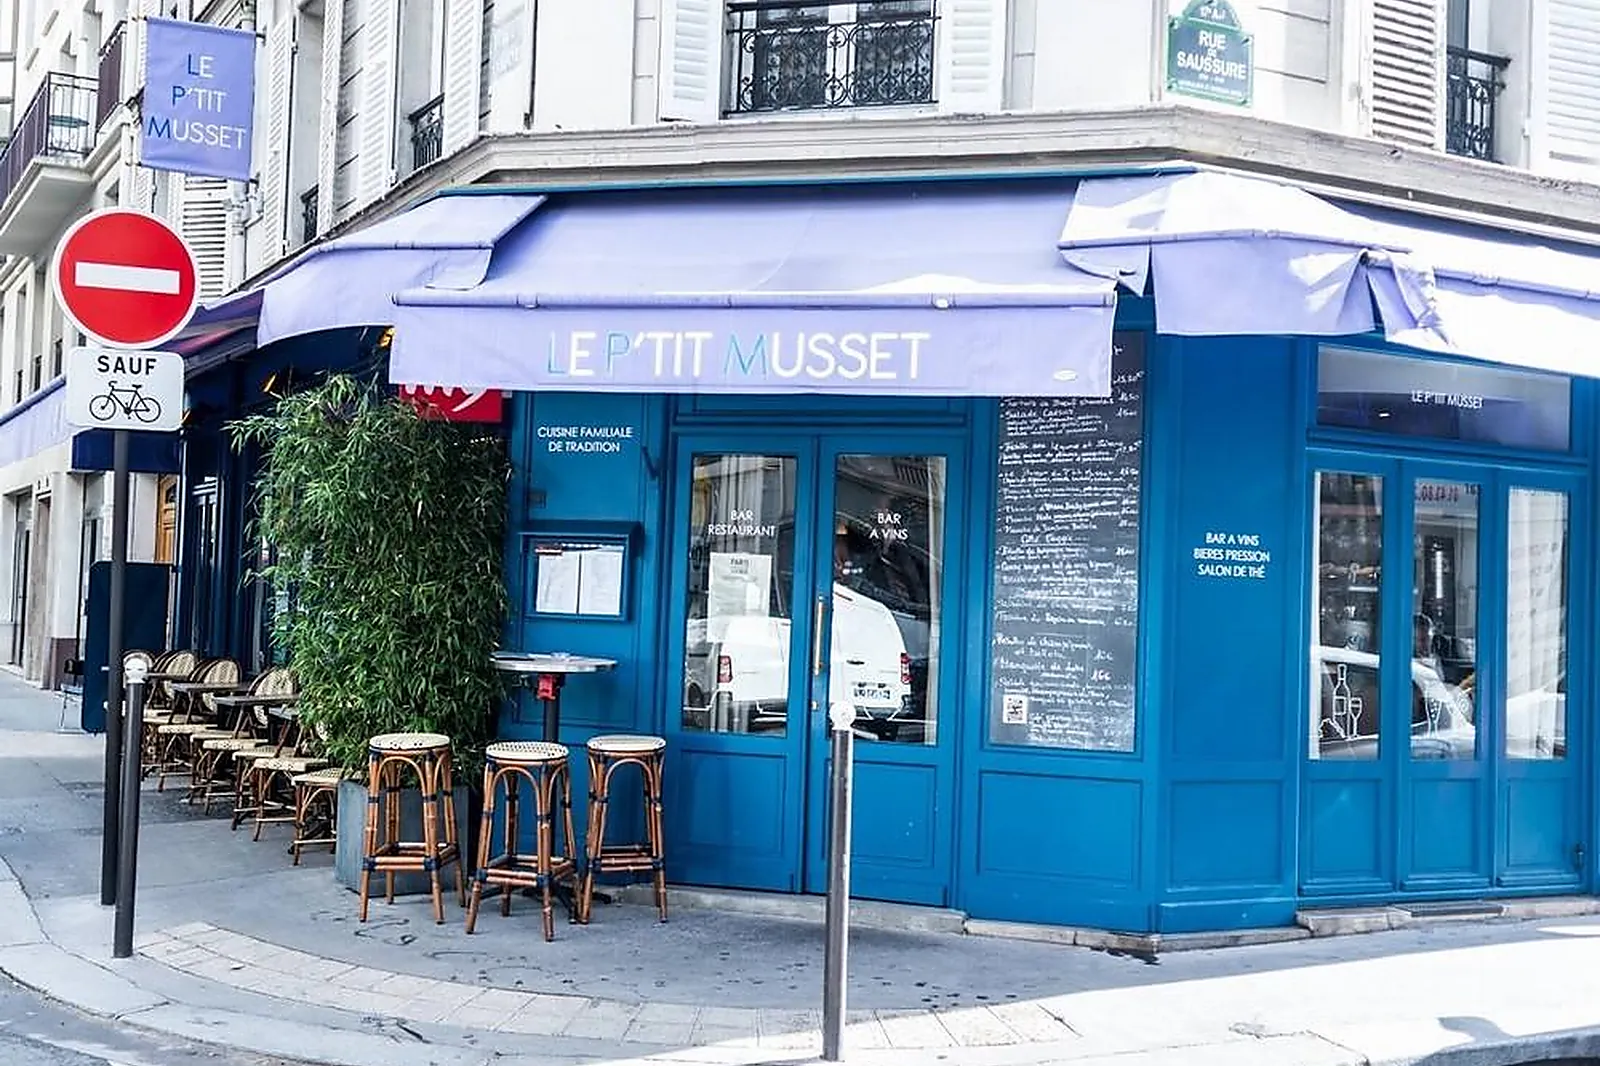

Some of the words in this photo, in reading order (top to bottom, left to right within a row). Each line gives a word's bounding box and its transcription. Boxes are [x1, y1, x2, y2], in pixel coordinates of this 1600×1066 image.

[1199, 30, 1226, 49] RUE
[187, 53, 214, 78] LE
[1177, 51, 1246, 79] SAUSSURE
[172, 85, 226, 112] P'TIT
[147, 115, 246, 149] MUSSET
[547, 331, 597, 377] LE
[606, 331, 713, 378] P'TIT
[723, 331, 931, 379] MUSSET
[97, 355, 157, 375] SAUF
[1411, 389, 1424, 402] LE
[1447, 394, 1483, 408] MUSSET
[537, 426, 579, 438] CUISINE
[580, 426, 634, 438] FAMILIALE
[548, 441, 563, 452] DE
[565, 441, 620, 453] TRADITION
[730, 509, 754, 521] BAR
[877, 512, 902, 525] BAR
[708, 524, 776, 537] RESTAURANT
[869, 529, 880, 539] A
[881, 529, 909, 541] VINS
[1206, 532, 1226, 545] BAR
[1227, 534, 1236, 545] A
[1237, 534, 1260, 546] VINS
[1193, 547, 1224, 560] BIERES
[1225, 549, 1270, 562] PRESSION
[1198, 563, 1232, 577] SALON
[1233, 565, 1248, 577] DE
